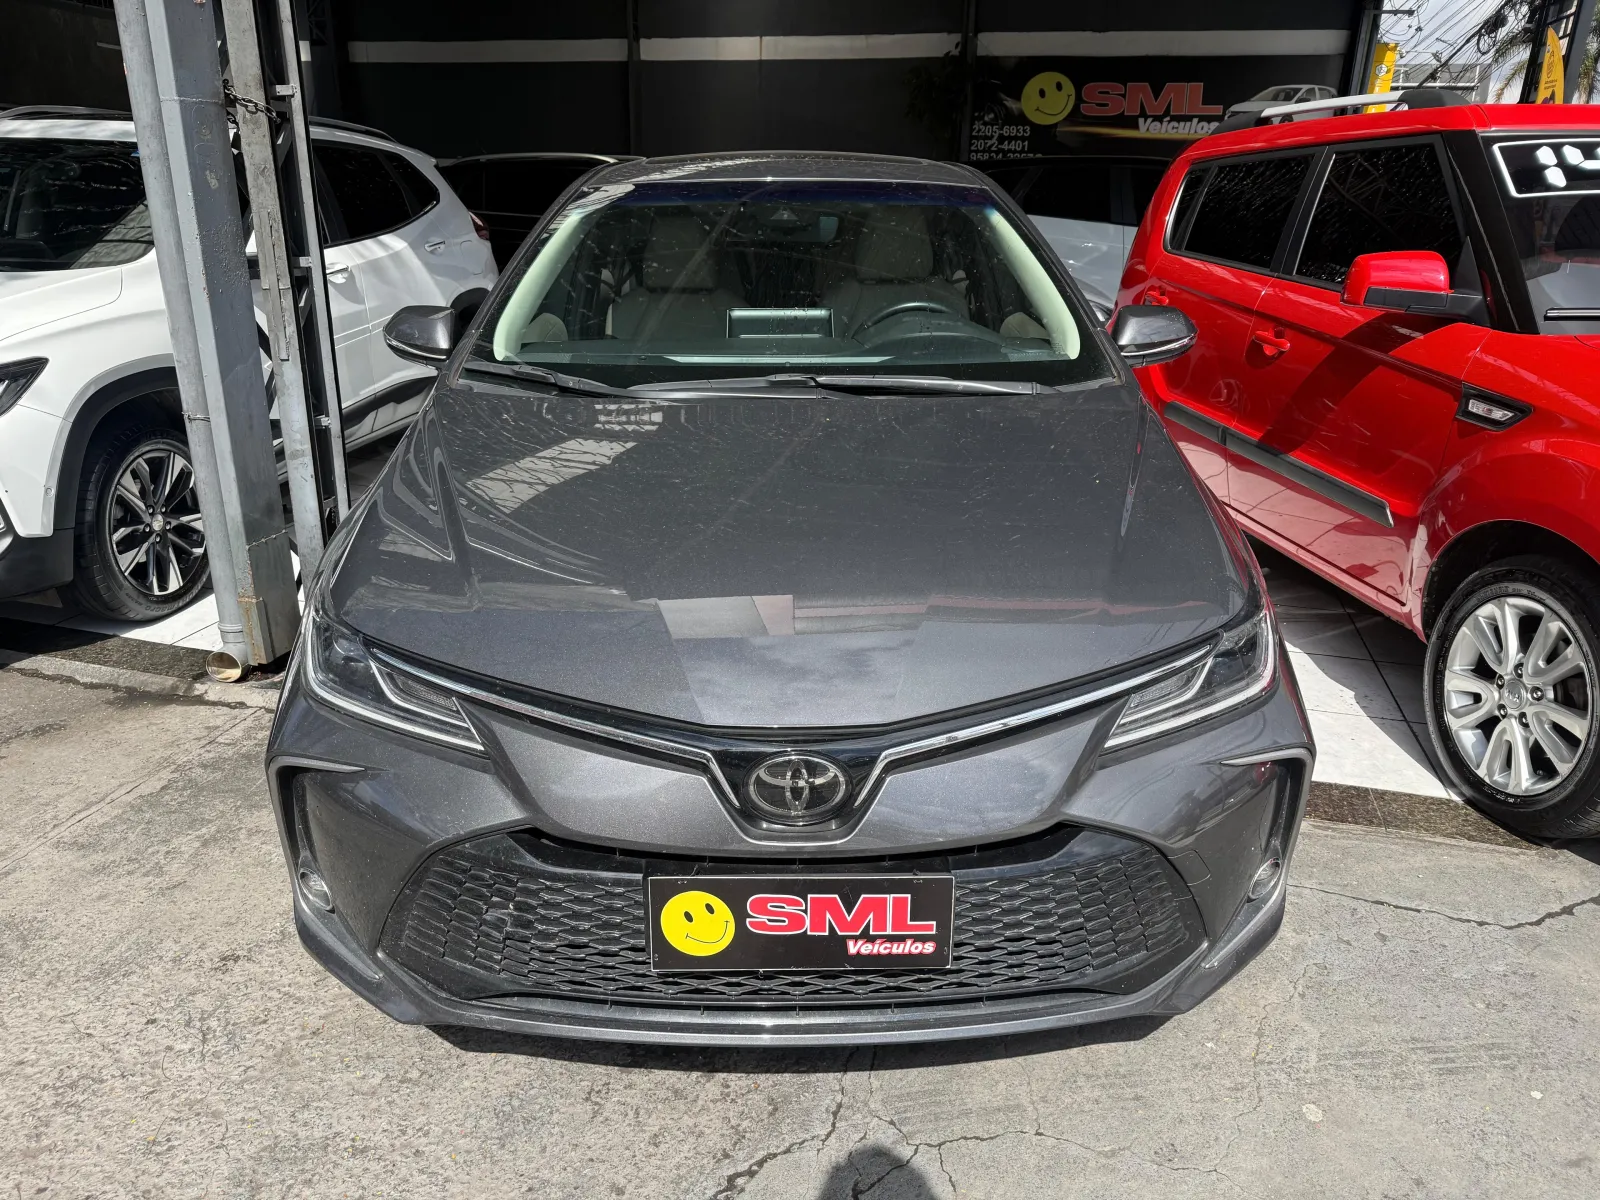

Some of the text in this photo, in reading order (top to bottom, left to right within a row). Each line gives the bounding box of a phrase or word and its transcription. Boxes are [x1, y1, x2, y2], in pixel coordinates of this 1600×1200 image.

[1080, 82, 1223, 116] SML
[971, 125, 1031, 137] 2205-6933
[1138, 116, 1220, 135] Veículos
[970, 139, 1029, 151] 2072-4401
[746, 893, 936, 936] SML
[846, 938, 936, 956] Veículos
